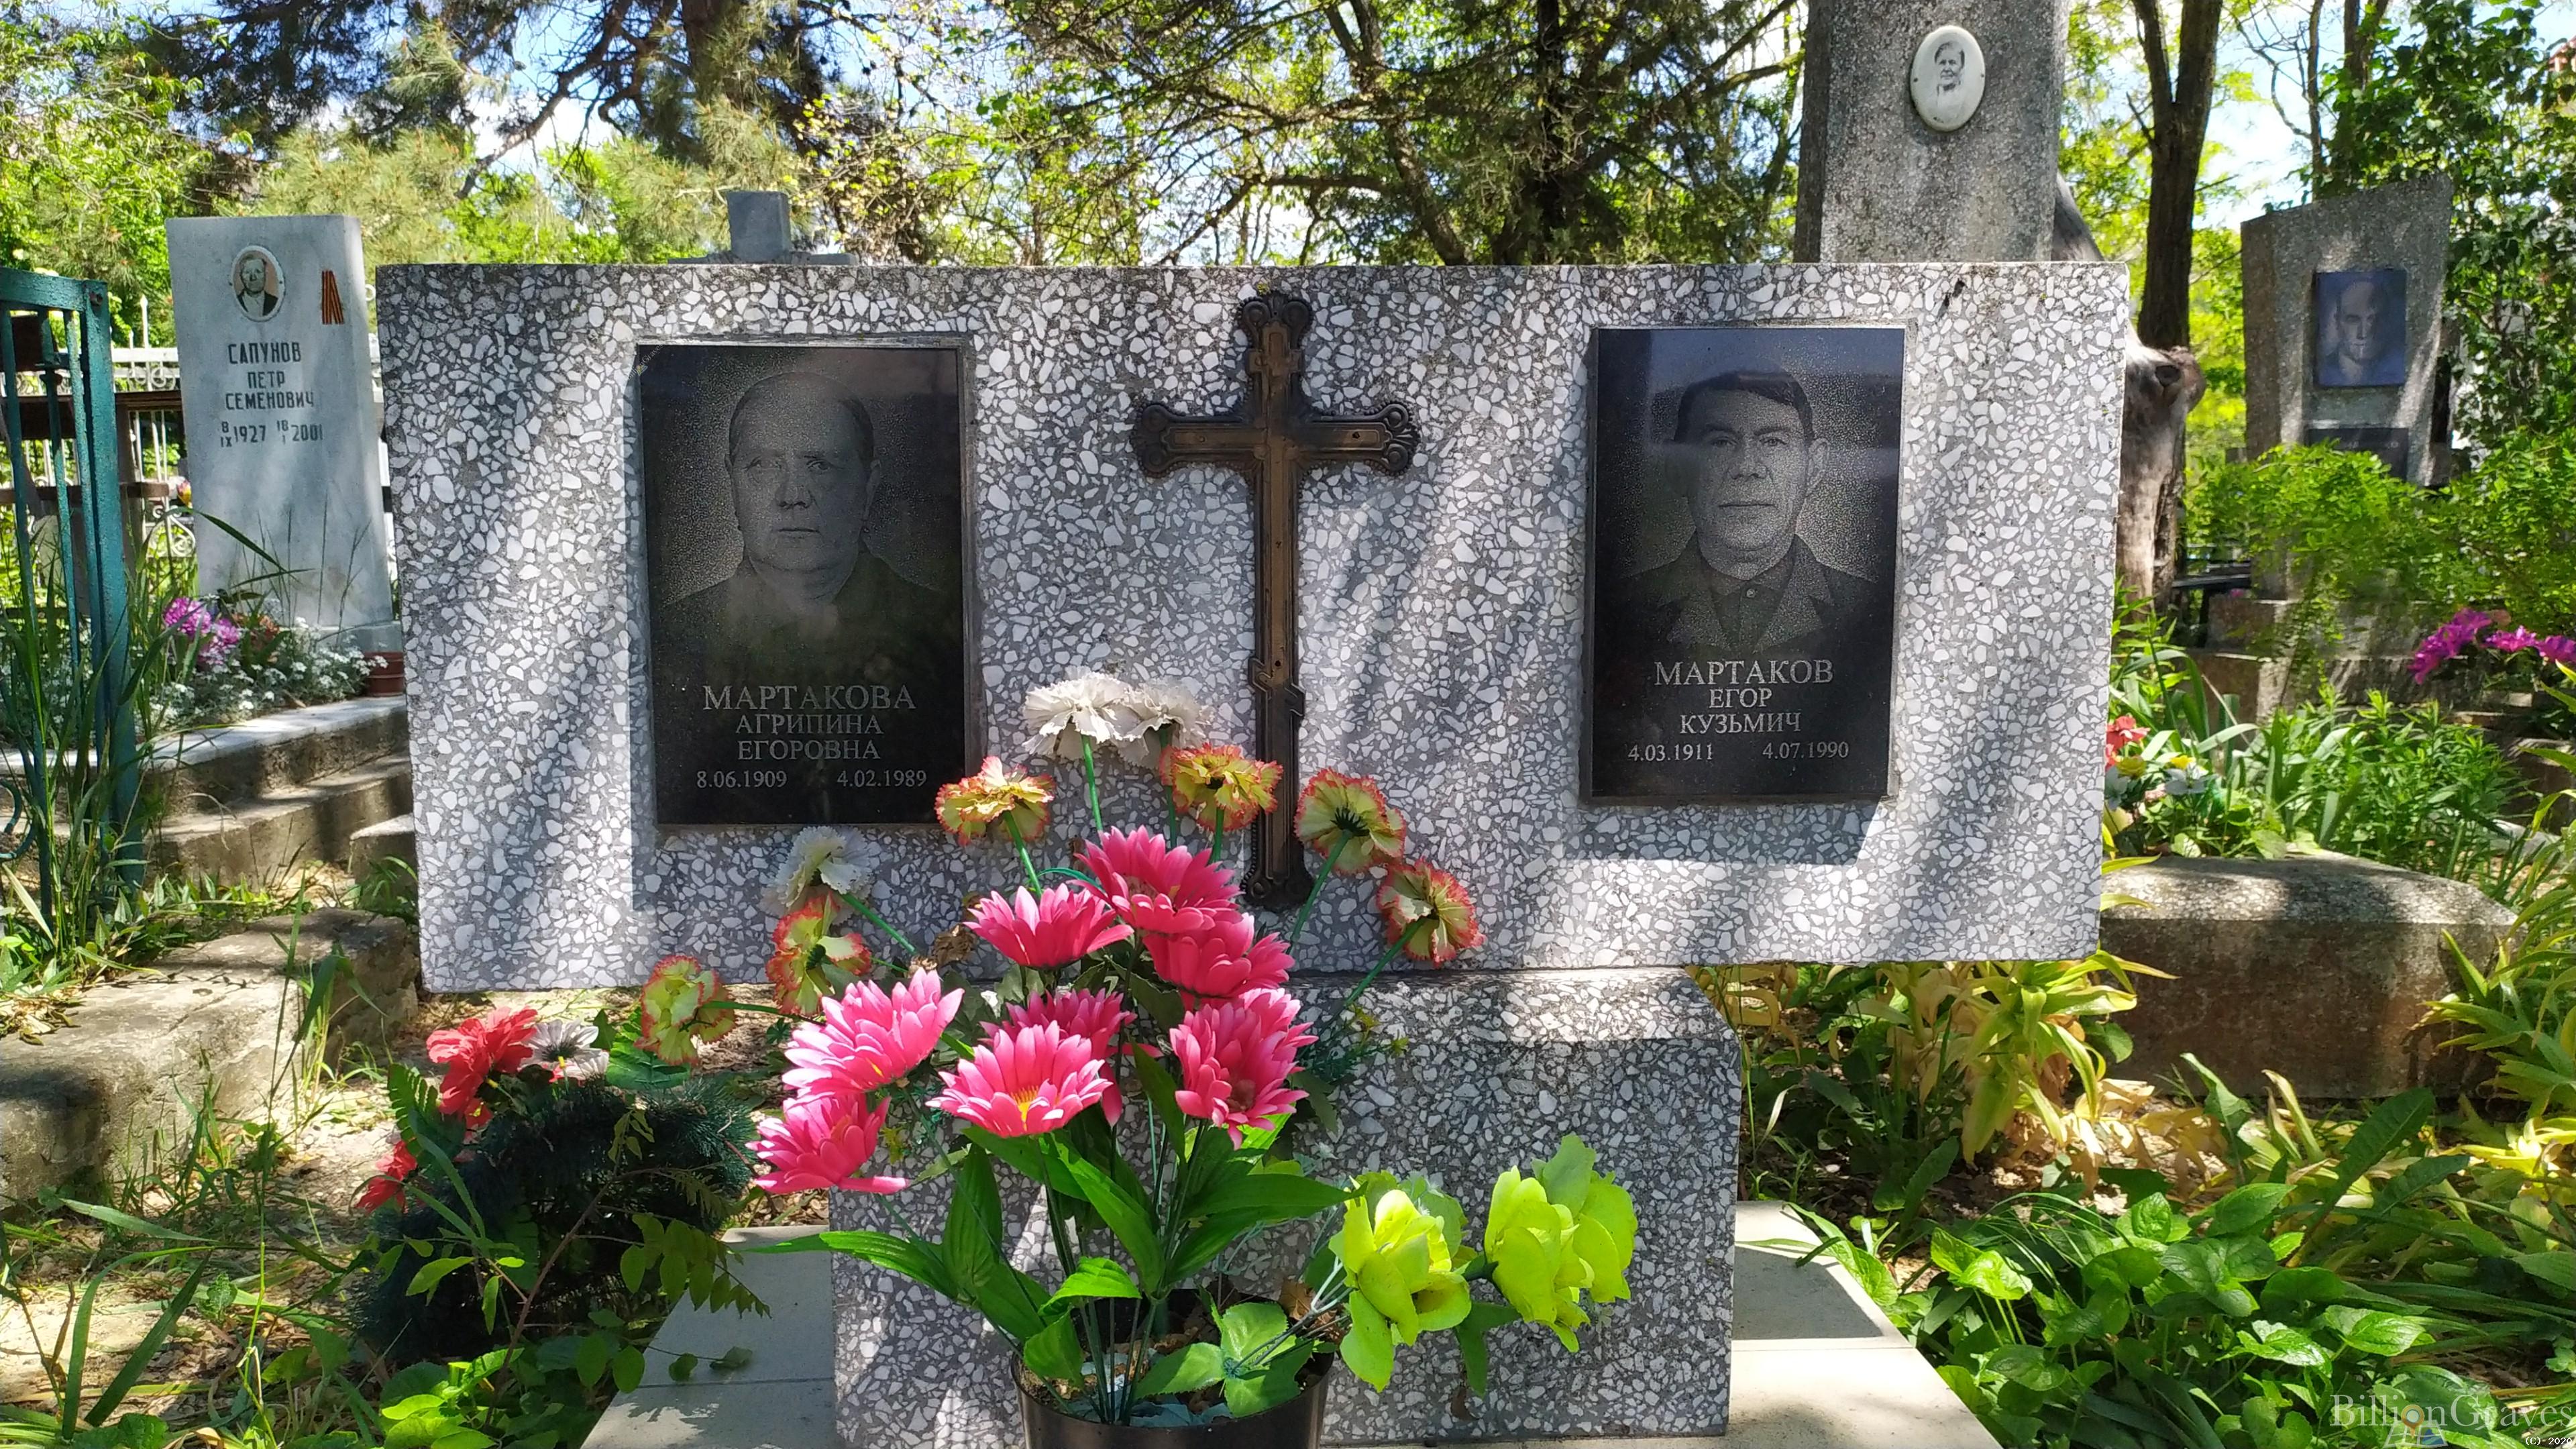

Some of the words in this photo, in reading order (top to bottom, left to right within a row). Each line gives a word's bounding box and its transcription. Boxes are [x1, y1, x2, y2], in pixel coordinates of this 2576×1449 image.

[228, 341, 301, 364] САПУНОВ
[248, 370, 285, 389] ПЕТР
[225, 390, 314, 411] СЕМЕНОВИЧ
[233, 425, 266, 443] 1927
[291, 424, 323, 442] 2001
[1654, 659, 1834, 686] МАРТАКОВ
[702, 684, 916, 710] МАРТАКОВА
[1709, 688, 1773, 709] ЕГОР
[736, 714, 884, 735] АГРИПИНА
[1680, 712, 1801, 735] КУЗЬМИЧ
[737, 739, 881, 760] ЕГОРОВНА
[1628, 743, 1713, 761] 4.03.1911
[1762, 741, 1849, 759] 4.07.1990
[696, 770, 787, 788] 8.06.1909
[837, 769, 927, 788] 4.02.1989
